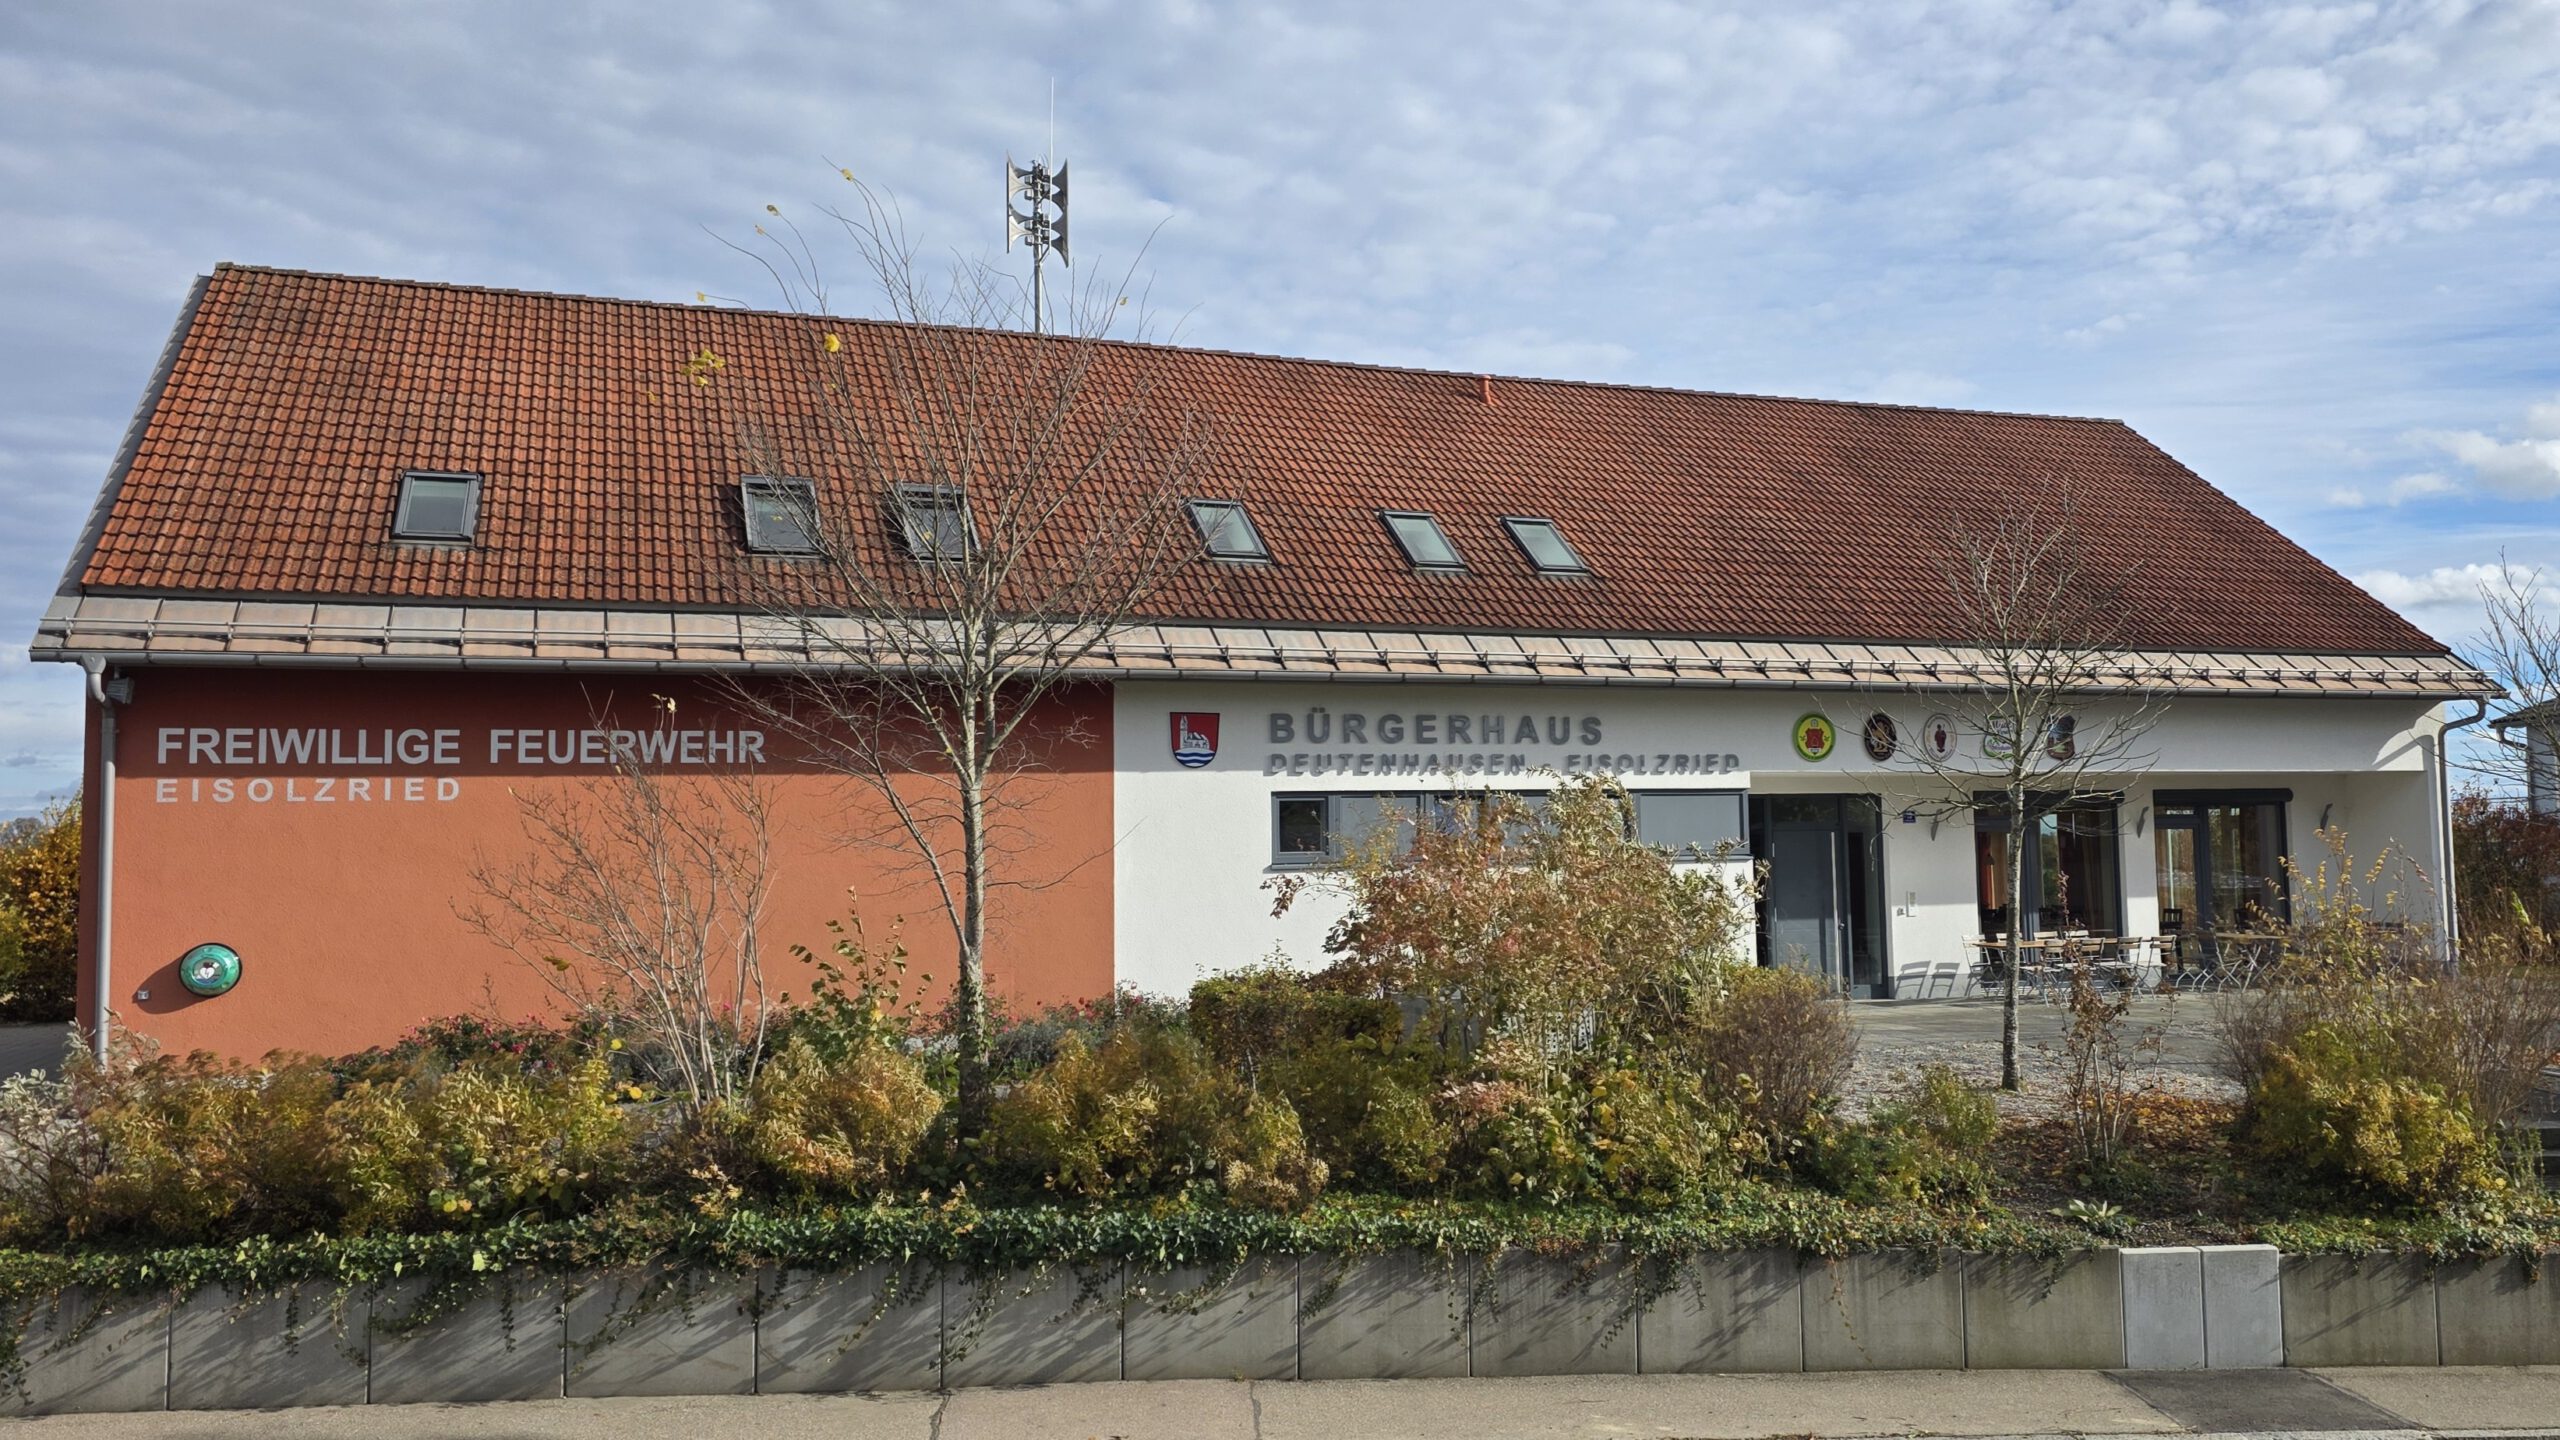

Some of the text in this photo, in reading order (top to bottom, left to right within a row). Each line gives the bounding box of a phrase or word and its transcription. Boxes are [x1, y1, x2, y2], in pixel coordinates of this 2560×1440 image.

[1269, 706, 1602, 746] BÜRGERHAUS
[157, 727, 767, 765] FREIWILLIGE FEUERWEHR
[1269, 753, 1526, 776] DEUTENHAUSEN
[1566, 753, 1740, 776] EISOLZRIED
[156, 777, 460, 803] EISOLZRIED
